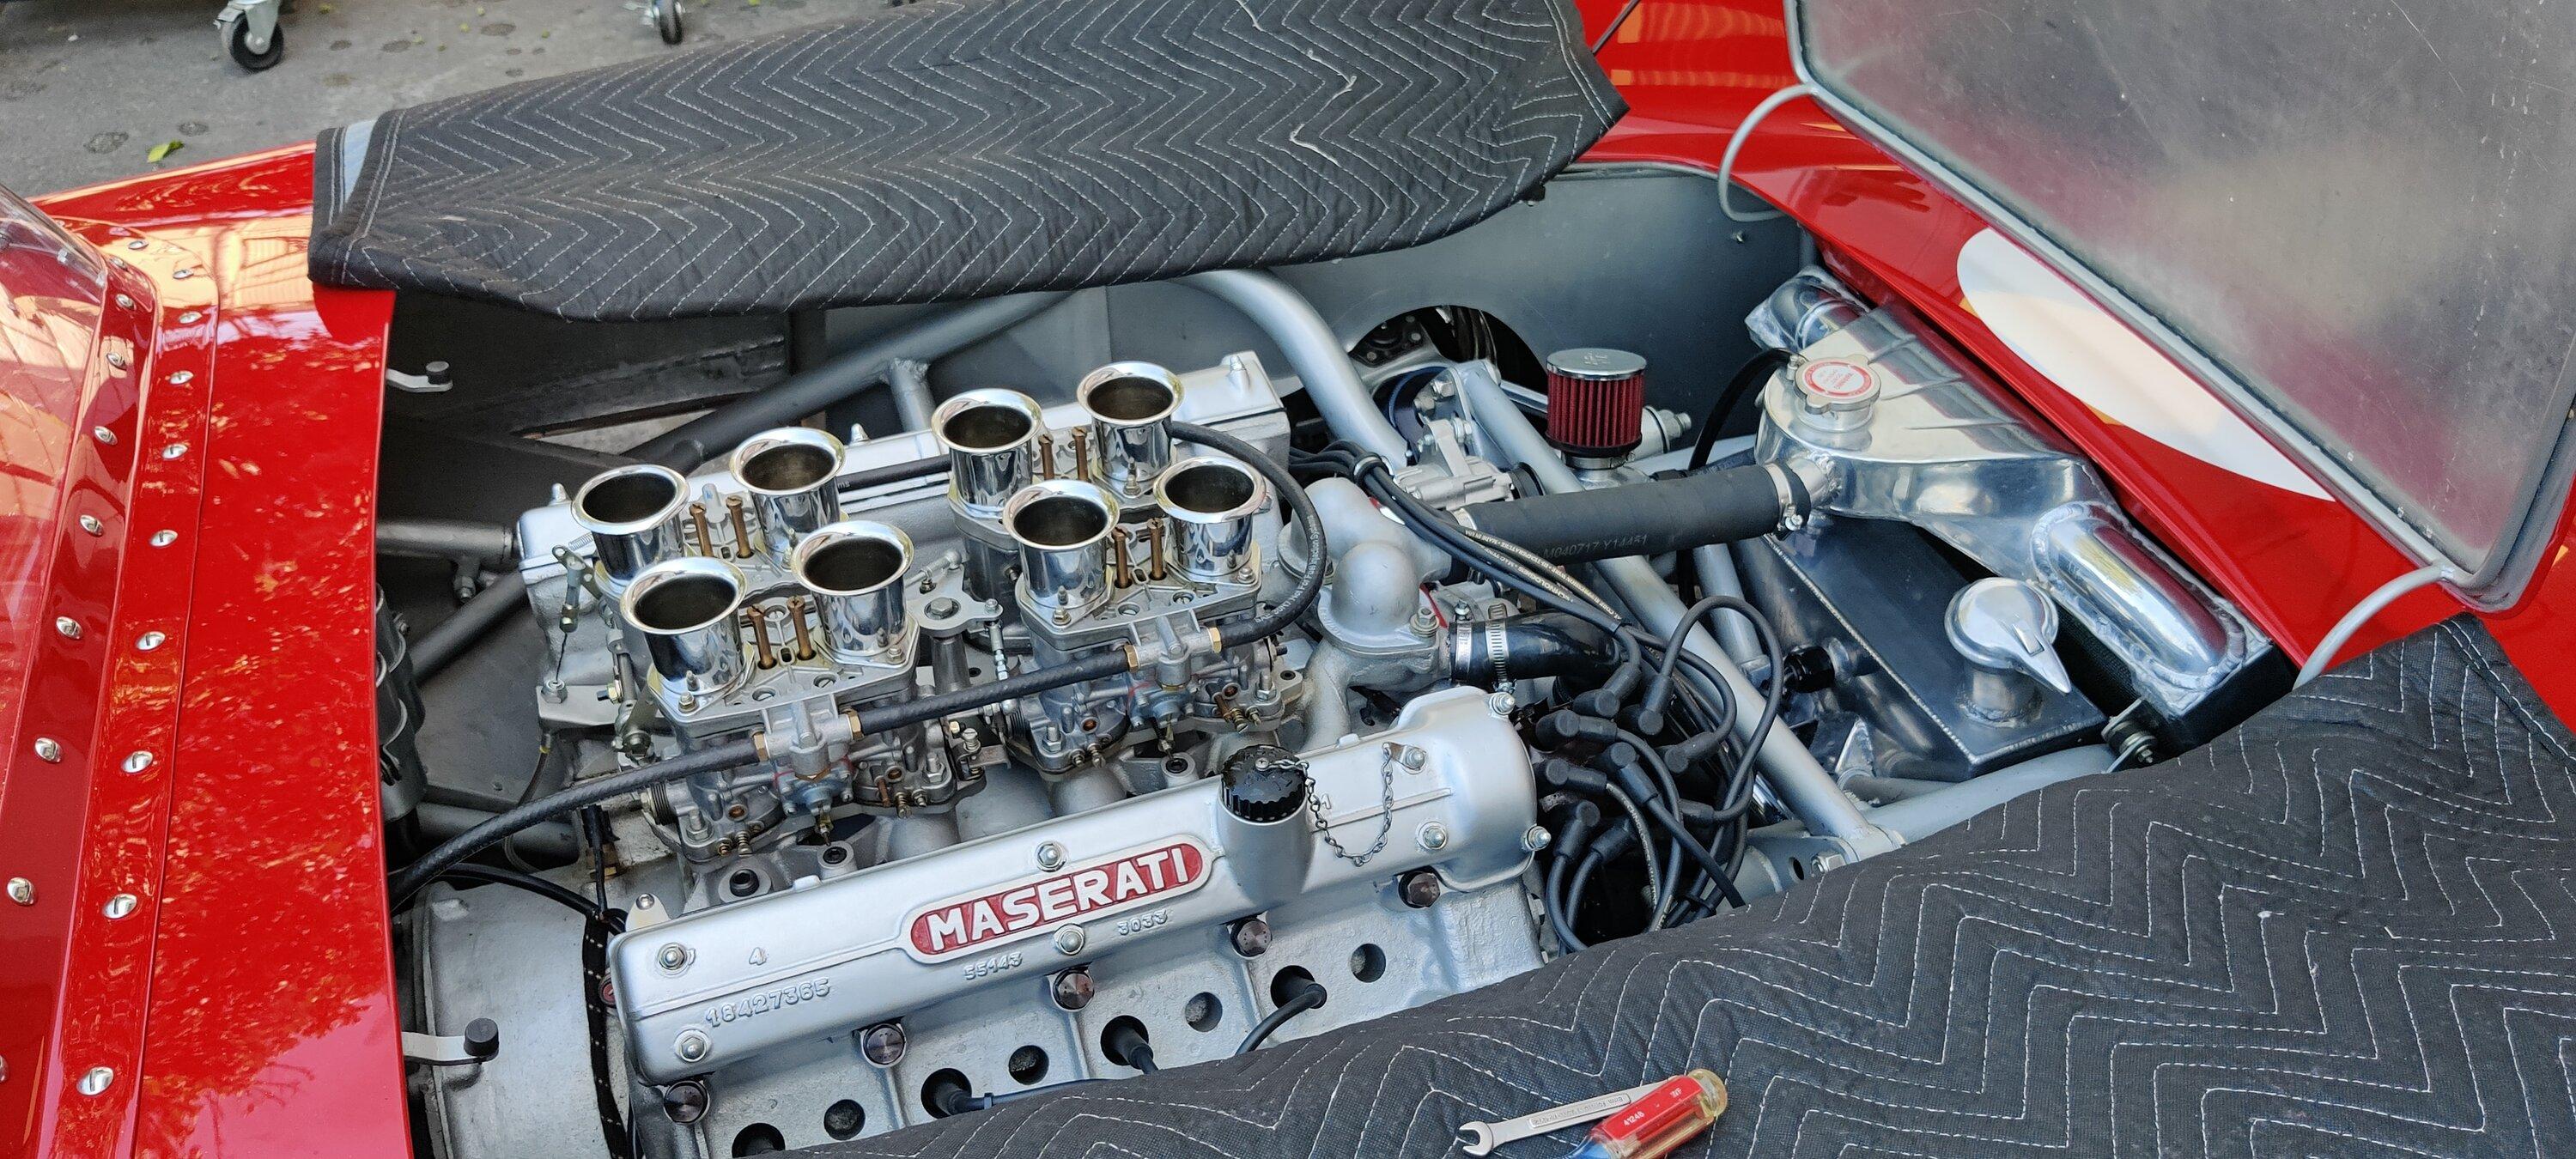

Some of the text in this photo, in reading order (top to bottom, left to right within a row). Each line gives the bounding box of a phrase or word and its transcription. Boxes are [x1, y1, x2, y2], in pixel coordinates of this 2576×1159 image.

[1307, 514, 1320, 539] Systems
[1309, 538, 1320, 564] Injection
[1304, 564, 1315, 579] Fuel
[928, 847, 1190, 951] MASERATI
[1117, 908, 1168, 937] 3033
[748, 947, 769, 967] 4
[963, 951, 1024, 981] 55143
[704, 976, 831, 1029] 18427365
